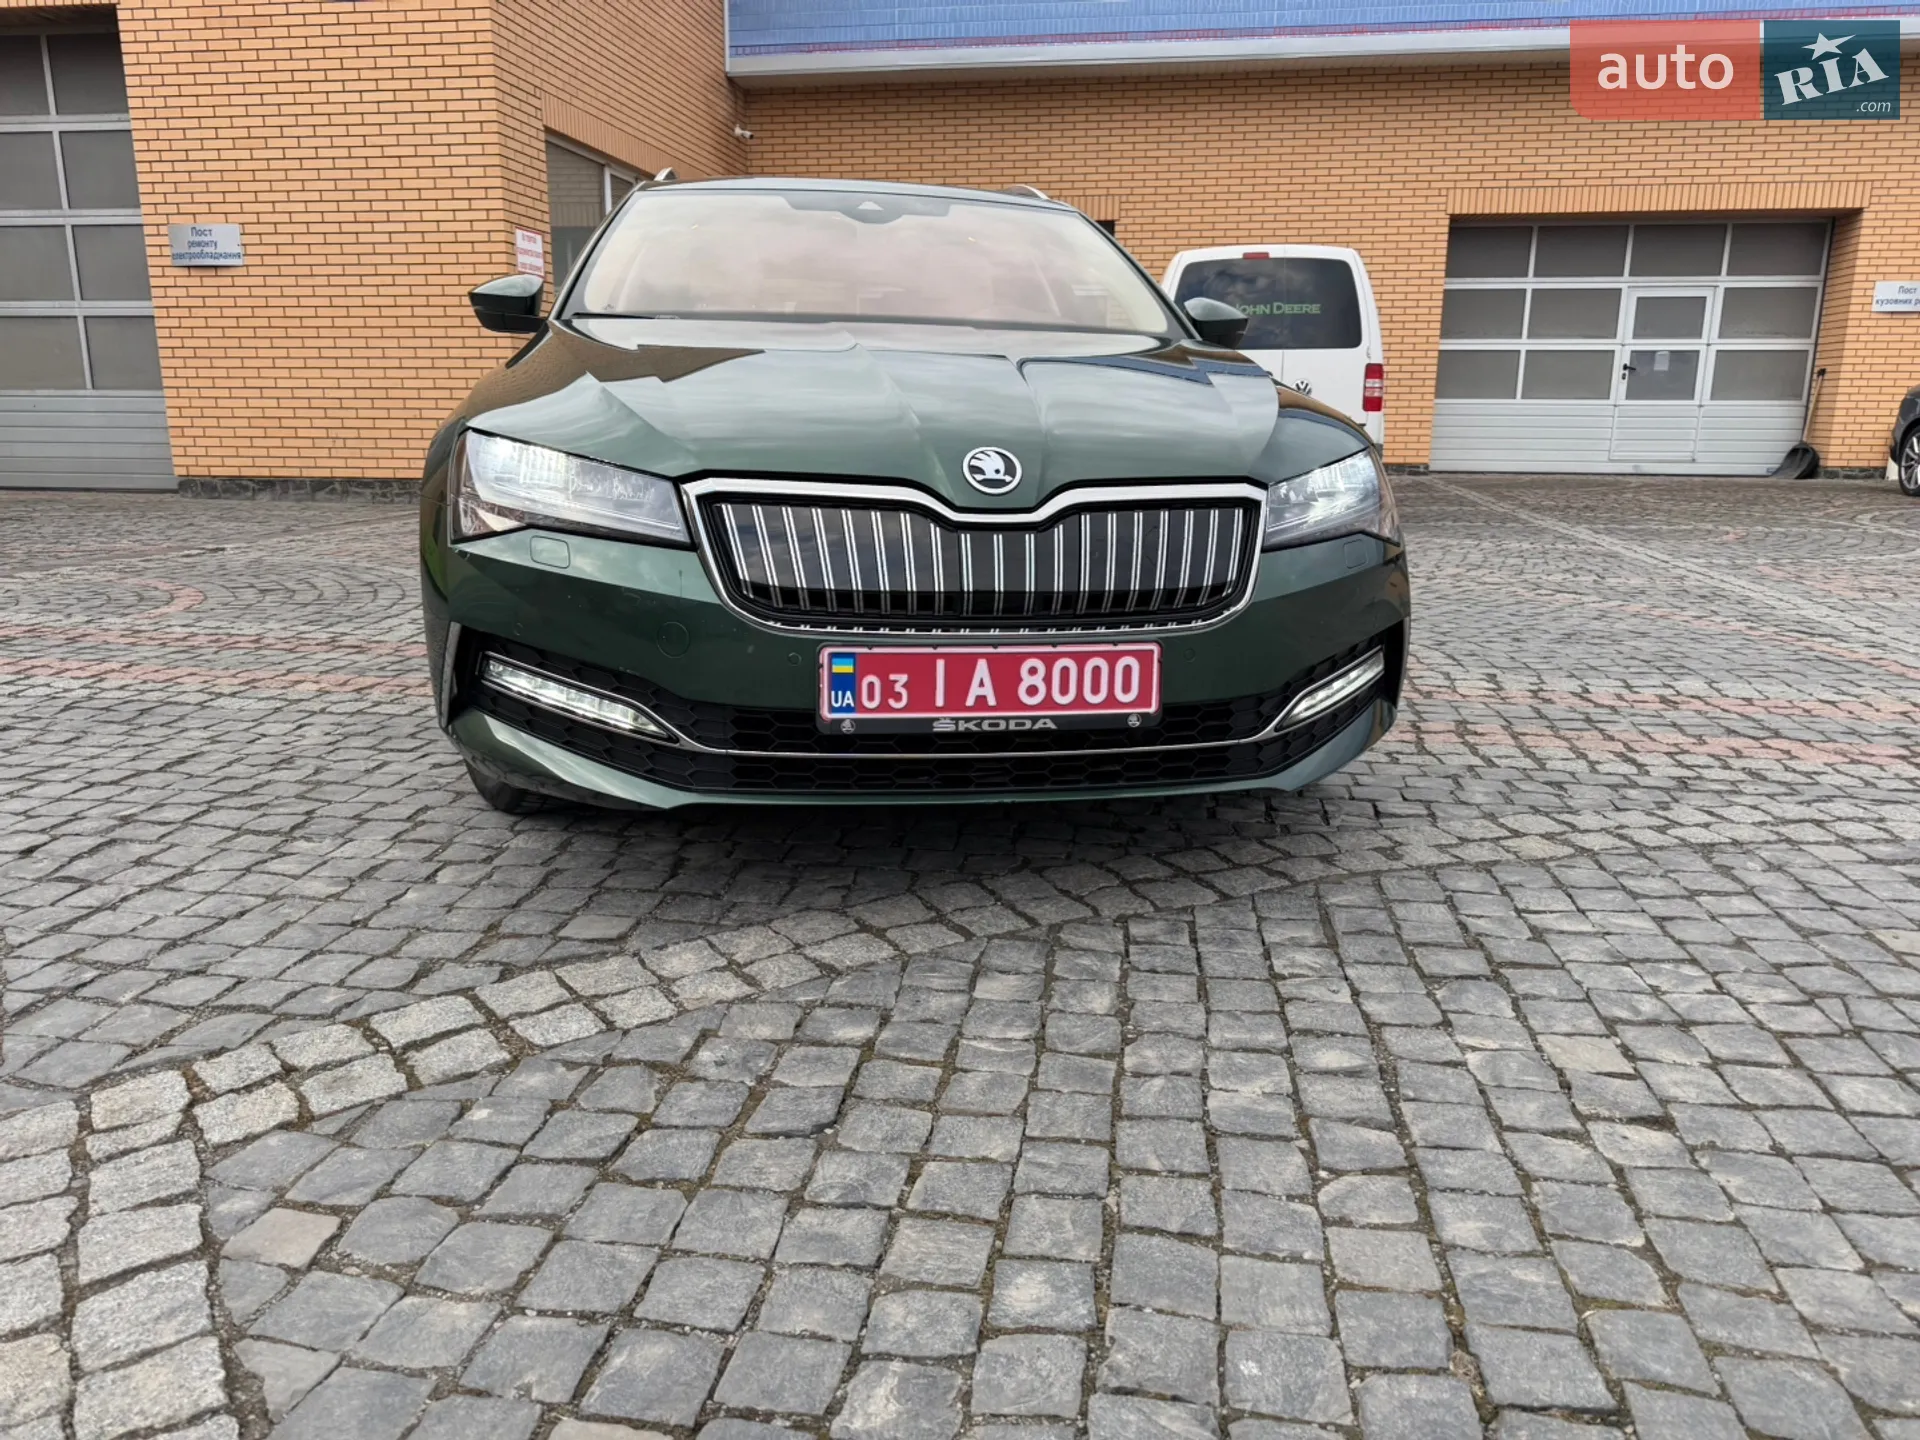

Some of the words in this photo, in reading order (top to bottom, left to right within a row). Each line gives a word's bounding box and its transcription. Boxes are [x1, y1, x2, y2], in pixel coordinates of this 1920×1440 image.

[190, 226, 213, 237] Пост
[187, 240, 218, 250] ремонту
[1898, 285, 1918, 295] Пост
[1273, 302, 1322, 315] DEERE
[861, 673, 909, 710] 03
[1017, 655, 1141, 707] 8000
[831, 690, 855, 708] UA
[932, 717, 1058, 733] ŠKODA
